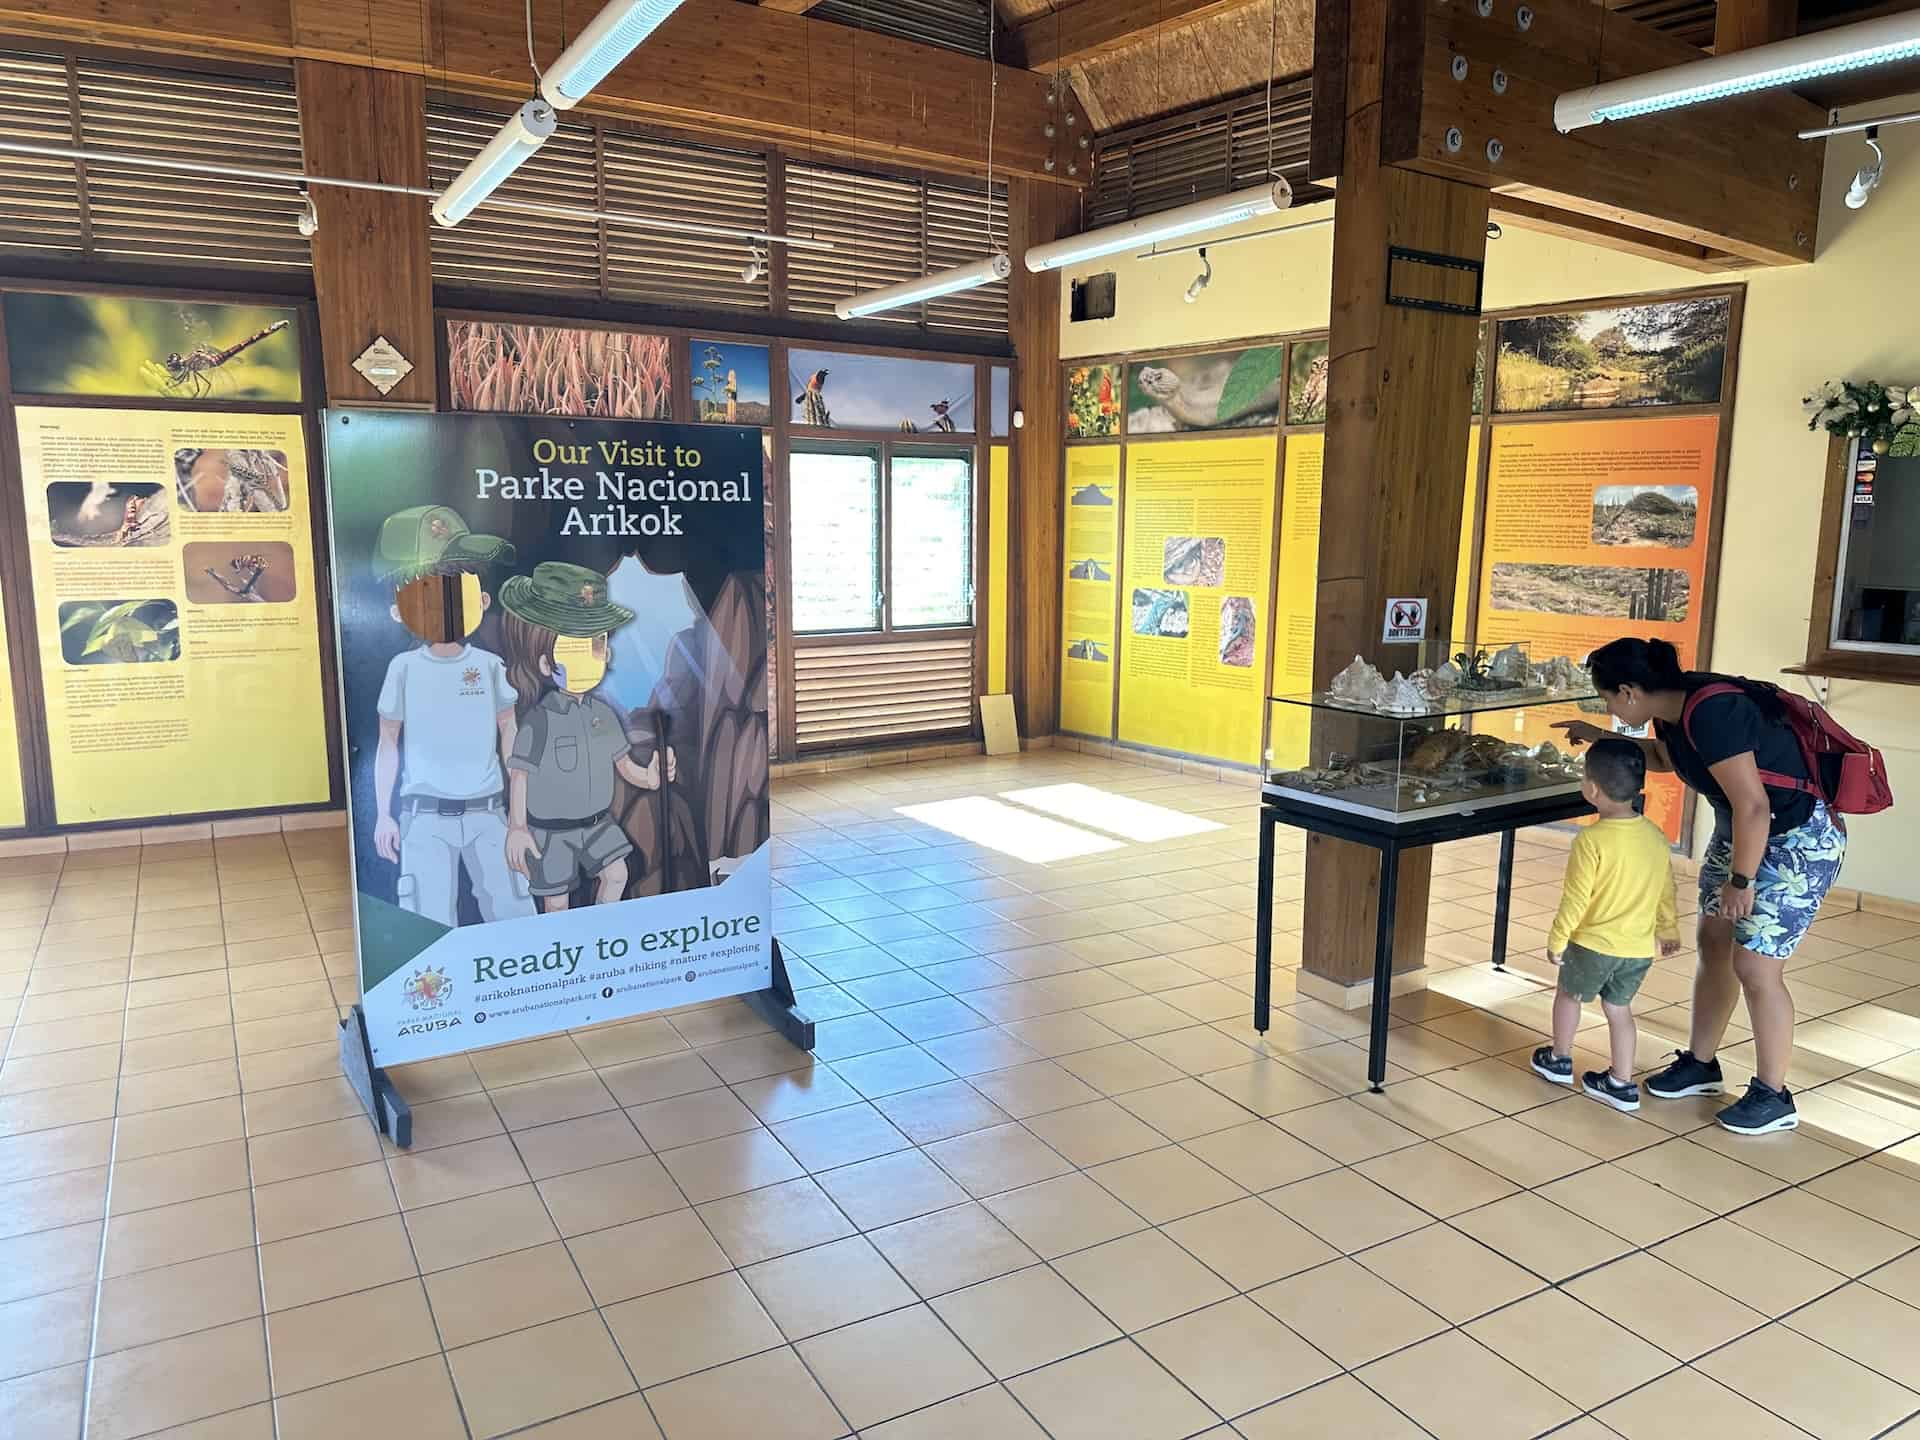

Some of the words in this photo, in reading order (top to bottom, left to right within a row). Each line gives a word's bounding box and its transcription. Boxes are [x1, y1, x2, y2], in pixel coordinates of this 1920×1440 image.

[533, 439, 592, 464] Our
[599, 440, 666, 467] Visit
[675, 445, 701, 467] to
[475, 468, 584, 500] Parke
[596, 471, 751, 502] Nacional
[560, 505, 683, 535] Arikok
[473, 941, 584, 983] Ready
[596, 936, 629, 960] to
[640, 914, 761, 953] explore
[475, 974, 587, 1002] #arikoknationalpark
[589, 968, 625, 981] #aruba
[629, 958, 667, 974] #hiking
[670, 952, 708, 966] #nature
[710, 943, 761, 959] #exploring
[397, 1016, 462, 1037] ARUBA
